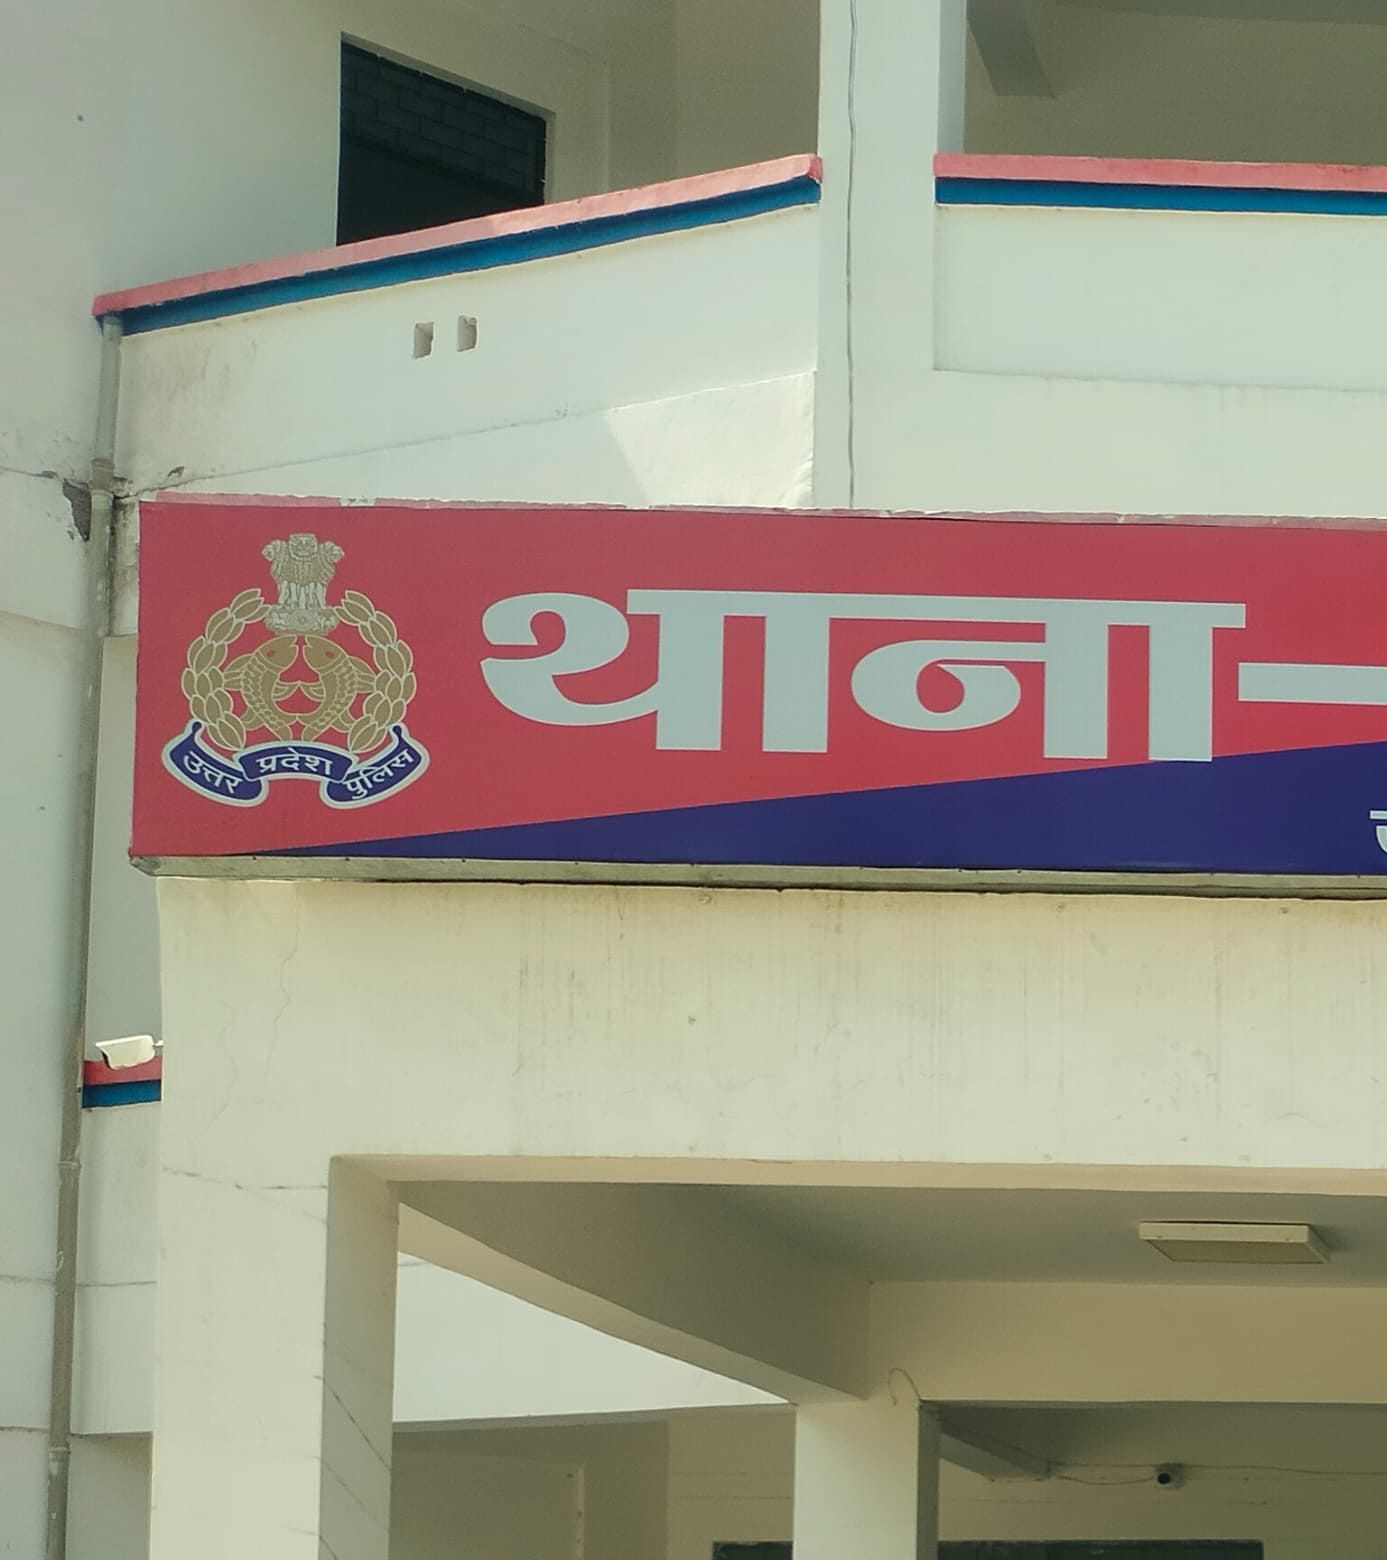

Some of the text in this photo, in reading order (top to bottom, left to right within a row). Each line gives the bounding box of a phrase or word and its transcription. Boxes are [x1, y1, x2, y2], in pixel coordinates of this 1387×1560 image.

[183, 747, 415, 800] उत्तर प्रदेश पुलिस
